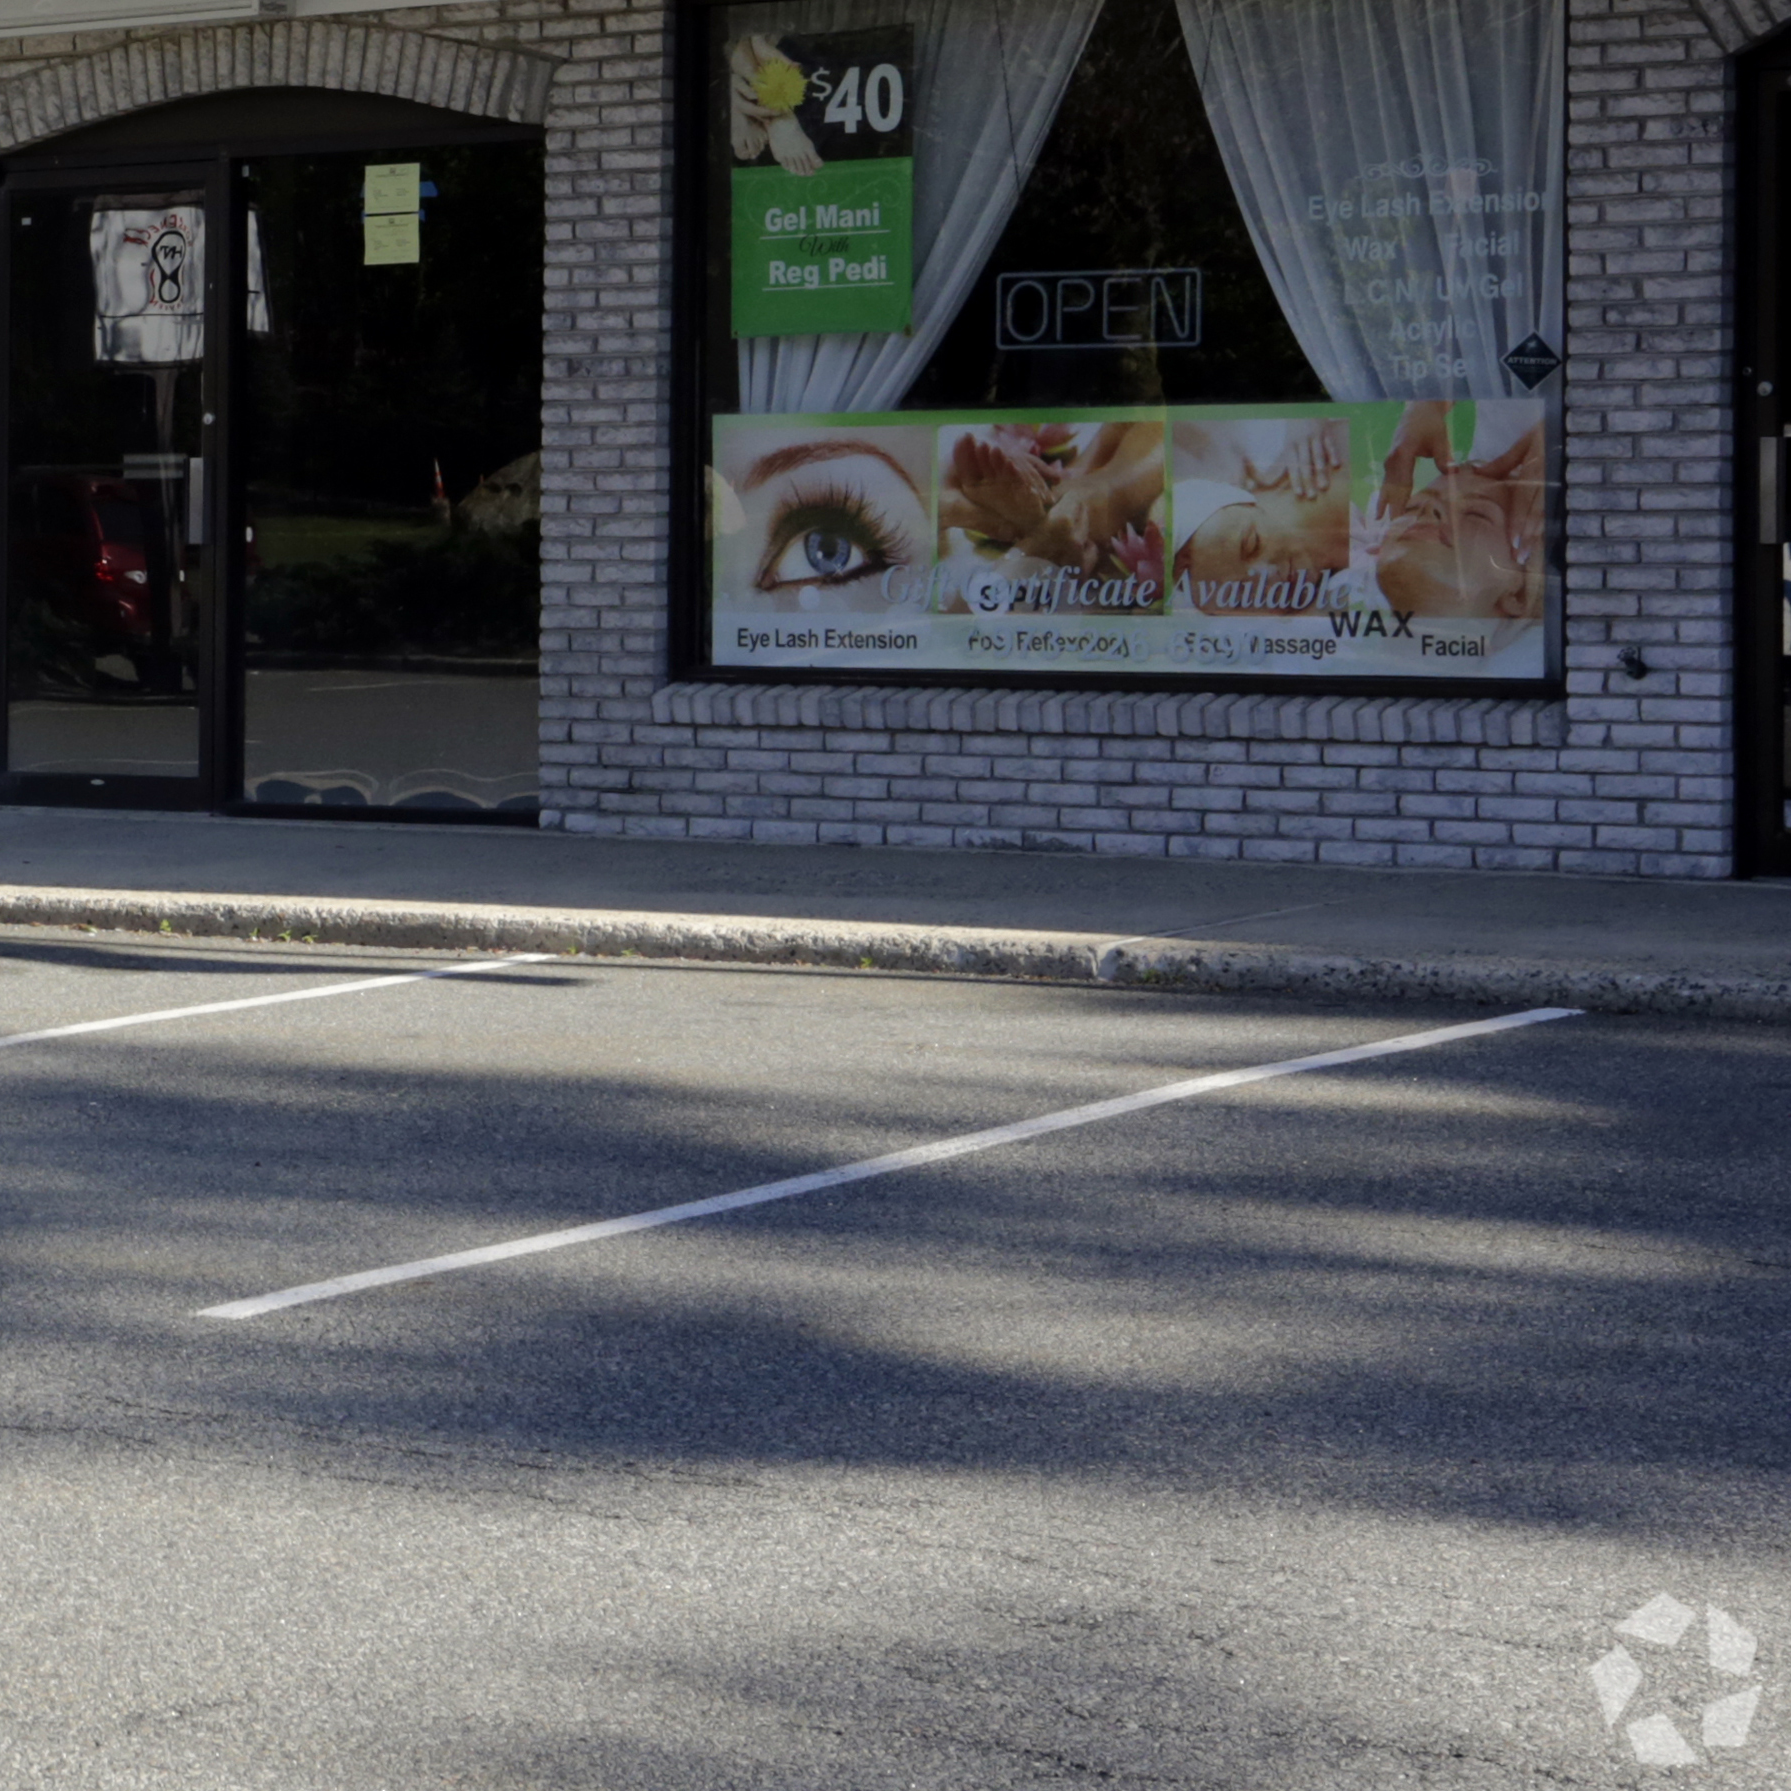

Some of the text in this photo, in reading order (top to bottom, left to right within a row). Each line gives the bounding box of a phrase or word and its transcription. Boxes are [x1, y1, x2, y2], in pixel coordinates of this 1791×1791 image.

[810, 63, 904, 134] $40
[765, 201, 880, 232] Gel Mani
[1308, 195, 1353, 227] Eye
[1361, 192, 1420, 218] Lash
[799, 235, 849, 257] With
[1344, 231, 1520, 260] Wax Facial
[769, 255, 887, 289] Reg Pedi
[1479, 273, 1523, 298] Gel
[1006, 275, 1191, 342] OPEN
[1389, 314, 1477, 346] Acrylic
[1389, 355, 1428, 385] Tip
[1507, 356, 1558, 366] ATTENTION
[881, 561, 1351, 615] Gift Certificate Available
[737, 627, 917, 652] Eye Lash Extension
[1329, 610, 1414, 639] WAX
[1421, 634, 1485, 657] Facial
